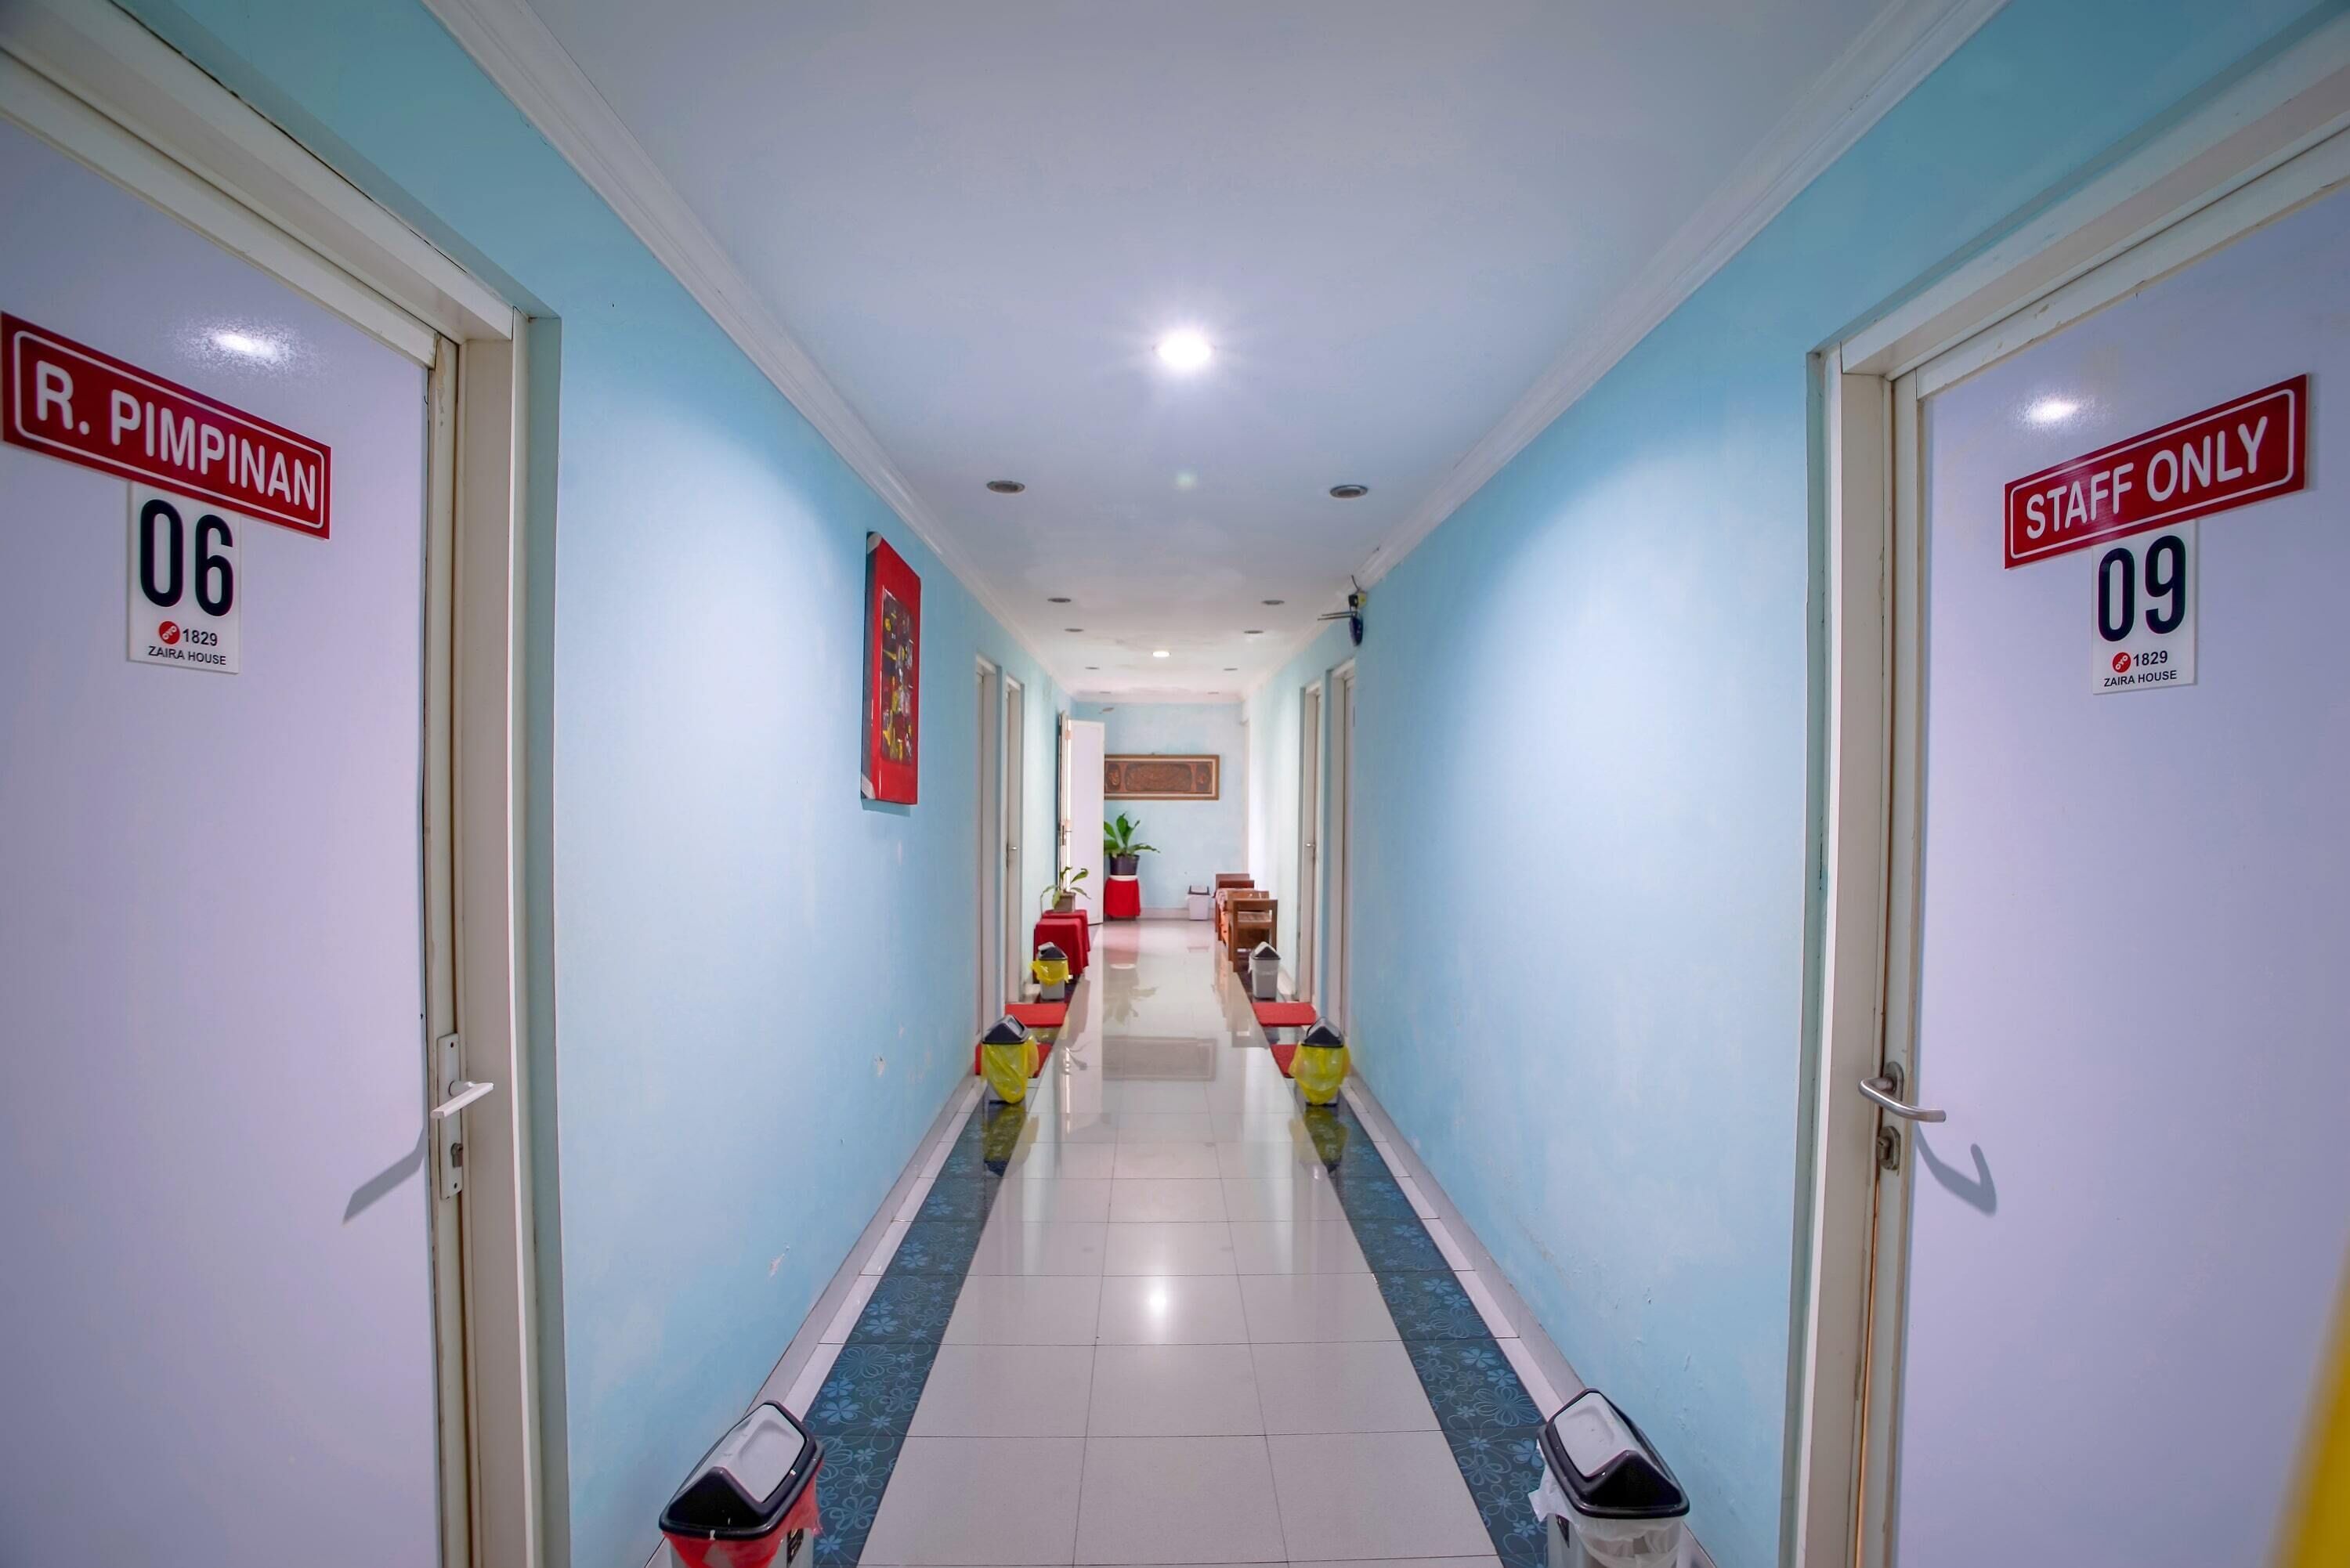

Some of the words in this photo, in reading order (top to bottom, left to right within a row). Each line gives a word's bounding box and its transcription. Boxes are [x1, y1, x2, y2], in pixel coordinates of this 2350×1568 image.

[36, 360, 90, 435] R.
[110, 388, 316, 511] PIMPINAN
[2026, 462, 2135, 540] STAFF
[2146, 416, 2268, 502] ONLY
[139, 499, 233, 616] 06
[2098, 535, 2186, 642] 09
[148, 645, 186, 659] ZAIRA
[188, 651, 226, 665] HOUSE
[183, 628, 218, 646] 1829
[2133, 650, 2168, 667] 1829
[2103, 675, 2135, 687] ZAIRA
[2138, 670, 2178, 683] HOUSE
